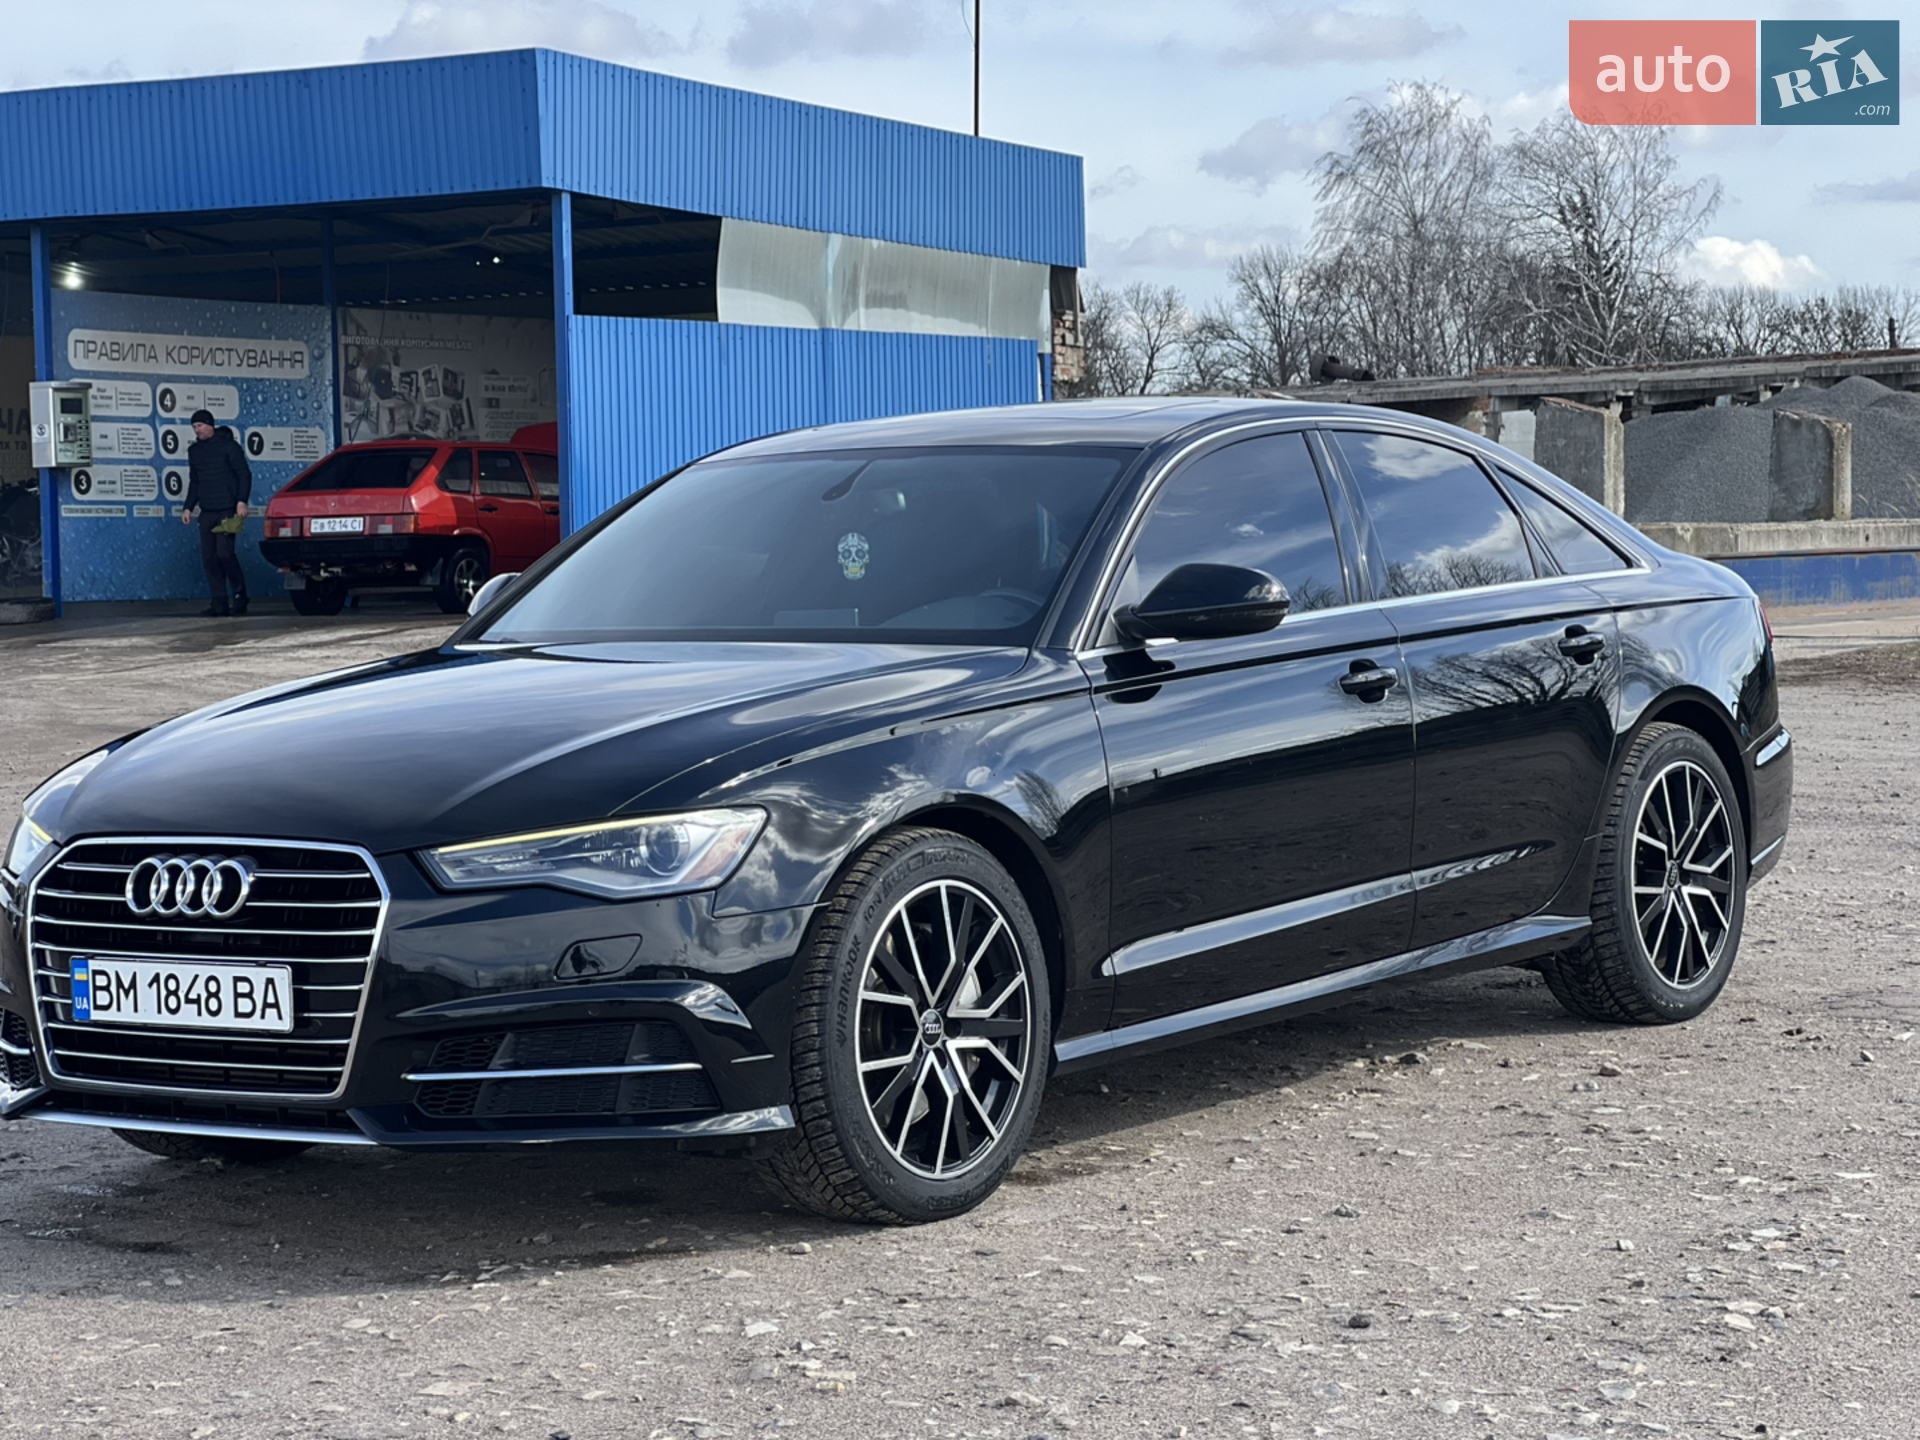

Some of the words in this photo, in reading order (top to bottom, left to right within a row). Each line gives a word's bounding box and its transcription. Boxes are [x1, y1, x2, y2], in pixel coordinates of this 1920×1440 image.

[73, 339, 159, 364] ПРАВИЛА
[165, 345, 305, 370] КОРИСТУВАННЯ
[327, 519, 349, 531] 1214
[75, 996, 89, 1010] UA
[91, 969, 139, 1013] BM
[147, 972, 223, 1017] 1848
[232, 976, 283, 1021] BA
